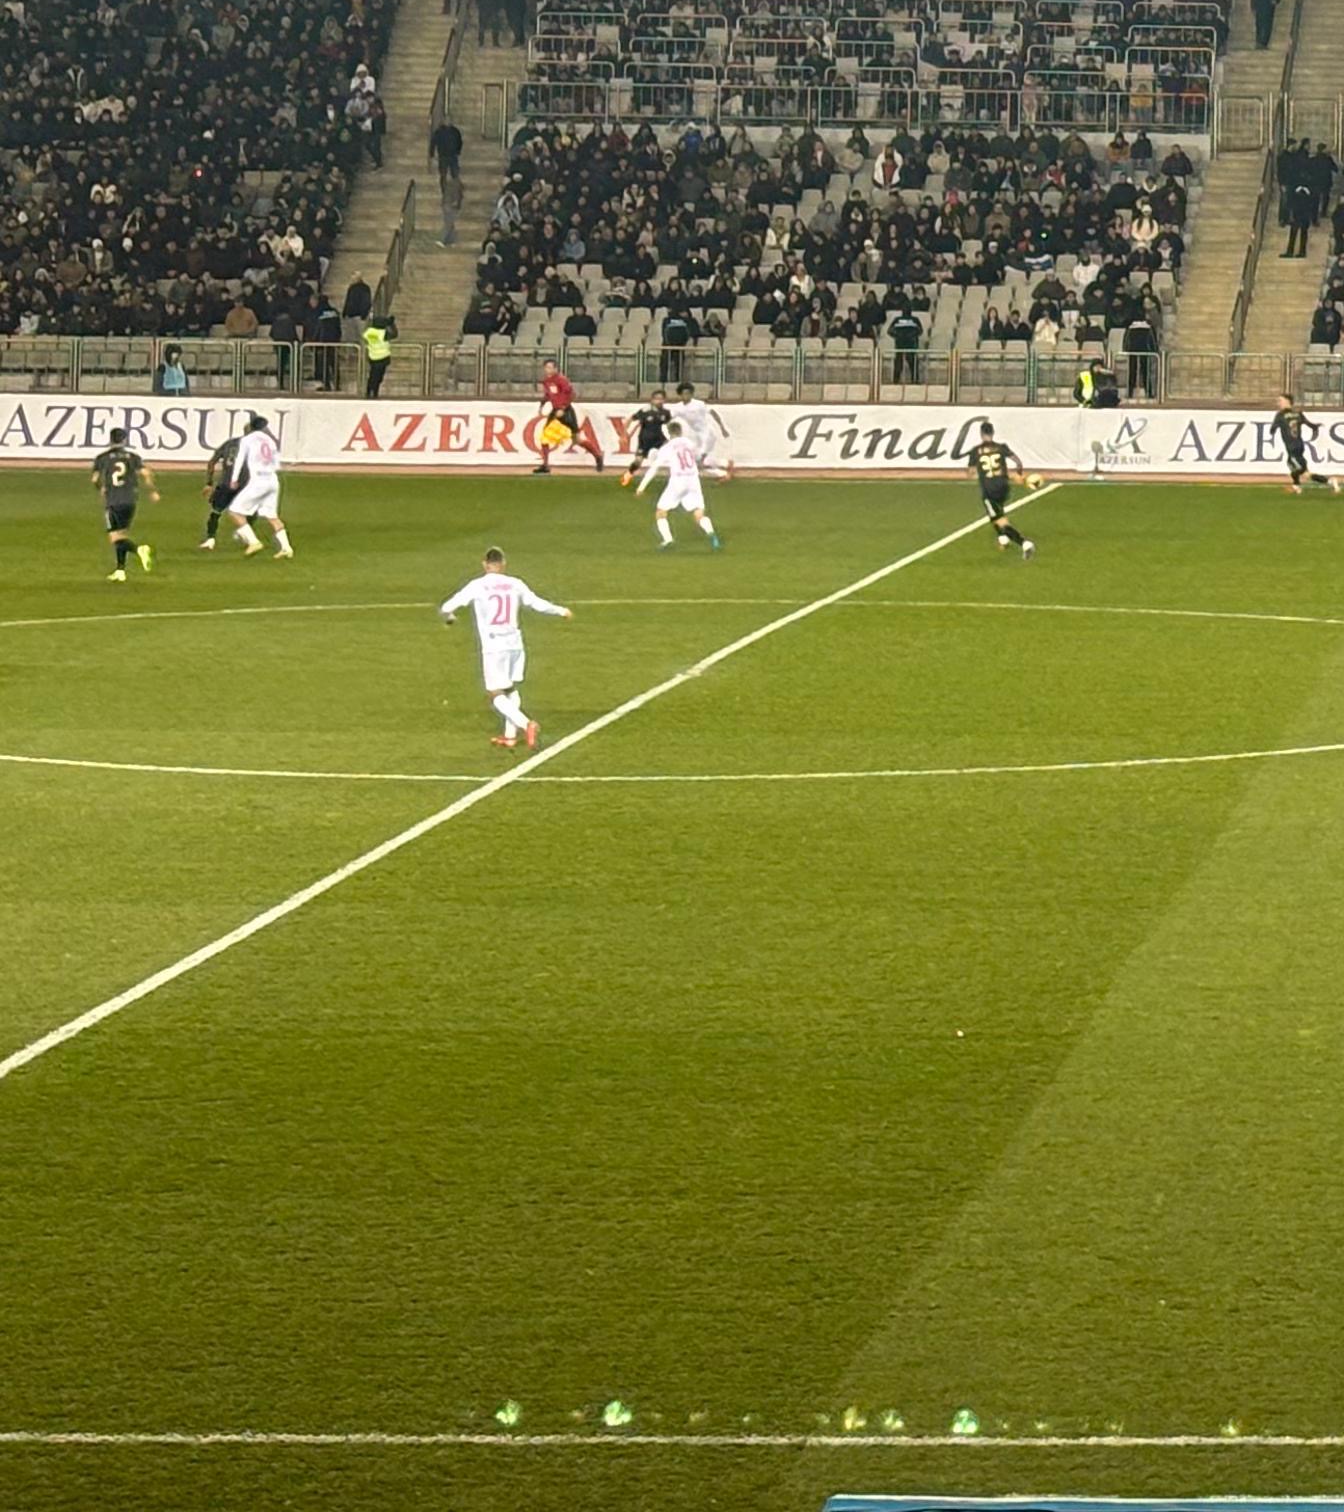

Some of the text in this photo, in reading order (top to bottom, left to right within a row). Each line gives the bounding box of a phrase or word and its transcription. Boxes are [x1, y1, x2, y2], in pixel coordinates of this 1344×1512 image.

[787, 414, 989, 460] Final
[112, 461, 126, 486] 2
[488, 594, 511, 625] 21
